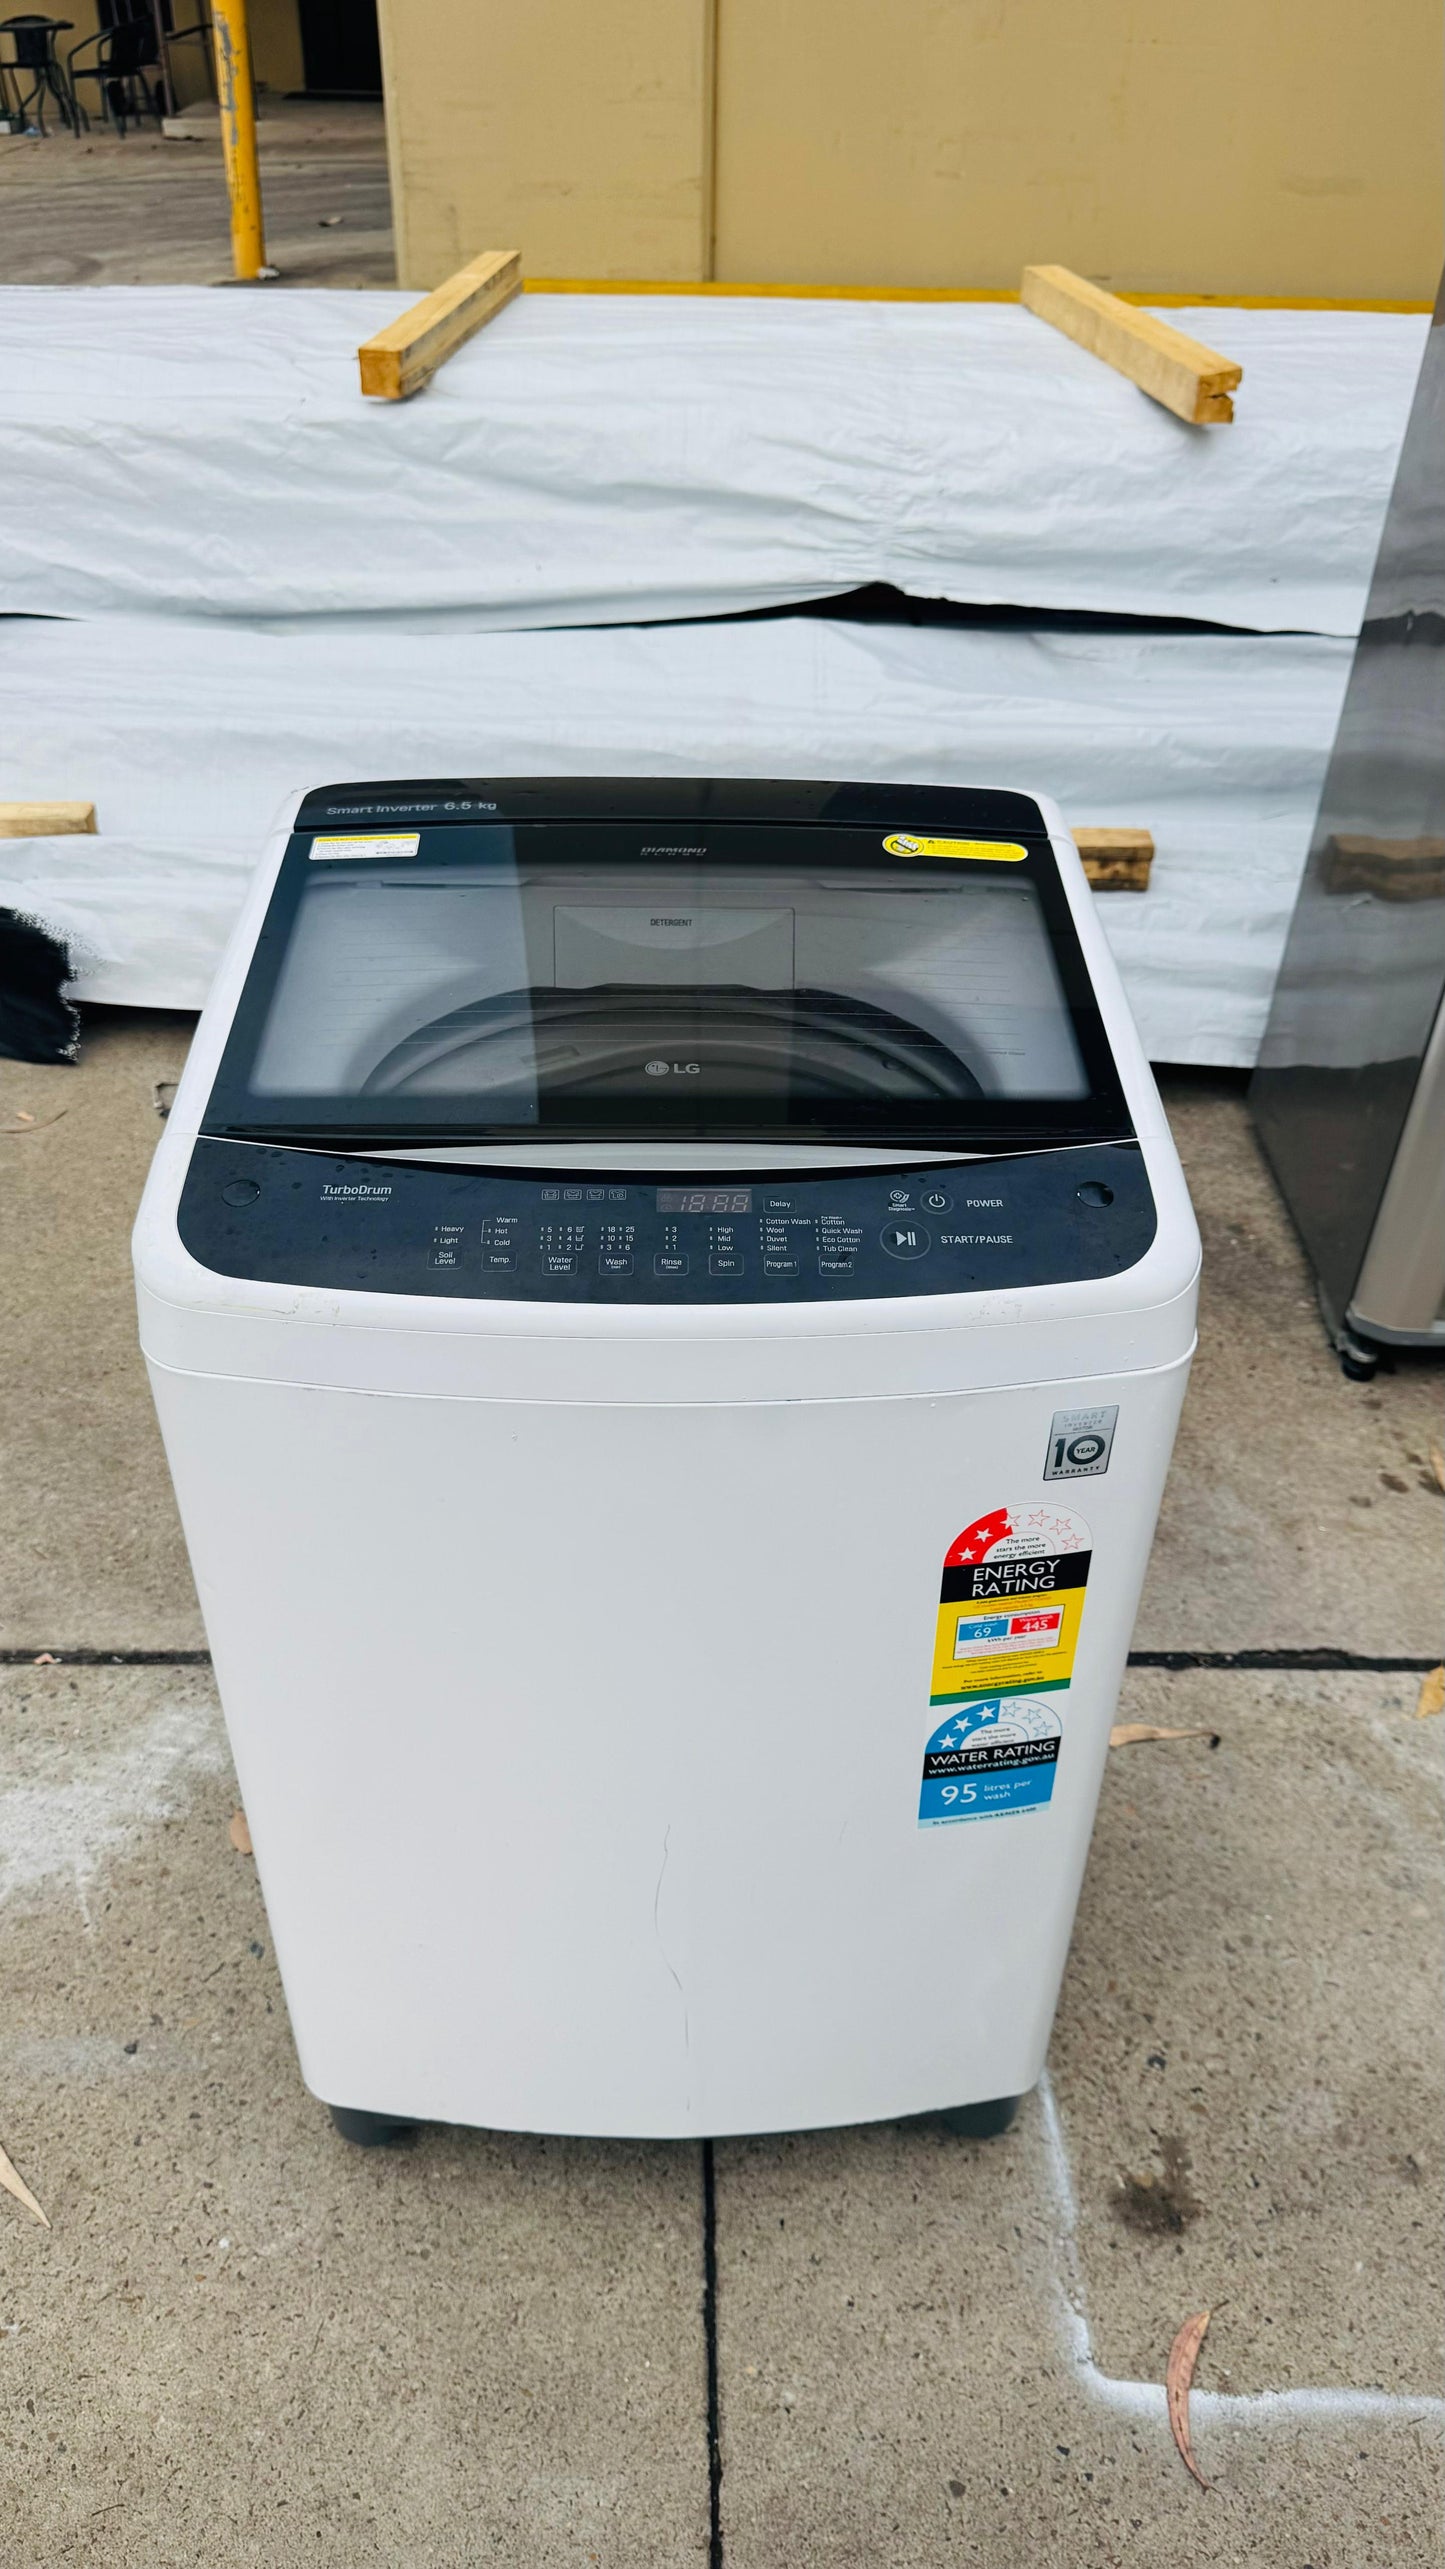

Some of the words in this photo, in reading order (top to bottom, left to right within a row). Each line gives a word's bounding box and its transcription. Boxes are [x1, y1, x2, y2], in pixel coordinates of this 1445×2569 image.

[326, 806, 373, 815] Smart
[376, 803, 438, 813] Inverter
[444, 801, 472, 811] 6.5
[478, 801, 497, 811] kg
[650, 918, 693, 927] DETERGENT
[673, 1063, 700, 1074] LG
[322, 1185, 392, 1195] TurboDrum
[769, 1200, 791, 1208] Delay
[966, 1199, 1003, 1208] POWER
[496, 1216, 518, 1224] Warm
[441, 1225, 465, 1233] Heavy
[717, 1226, 734, 1234] High
[439, 1237, 459, 1245] Light
[940, 1235, 1014, 1244] START/PAUSE
[766, 1244, 787, 1252] Silent
[438, 1251, 454, 1259] Soil
[548, 1256, 573, 1264] Water
[605, 1258, 628, 1266] Wash
[661, 1258, 682, 1266] Rinse
[717, 1259, 735, 1268] Spin
[766, 1260, 793, 1269] Program
[549, 1263, 571, 1271] Level
[821, 1261, 848, 1269] Program
[1054, 1434, 1106, 1468] 10
[1076, 1446, 1097, 1454] YEAR
[1051, 1465, 1100, 1476] WARRANTY
[993, 1552, 1017, 1560] energy
[1018, 1548, 1045, 1557] efficient
[973, 1559, 1061, 1582] ENERGY
[972, 1575, 1056, 1597] RATING
[1022, 1619, 1049, 1632] 445
[974, 1627, 992, 1638] 69
[930, 1751, 989, 1767] WATER
[993, 1740, 1056, 1760] RATING
[928, 1752, 1056, 1775] www.waterrating.gov.au
[983, 1783, 1011, 1793] litres
[1013, 1779, 1033, 1790] per
[940, 1782, 978, 1806] 95
[983, 1791, 1011, 1801] wash
